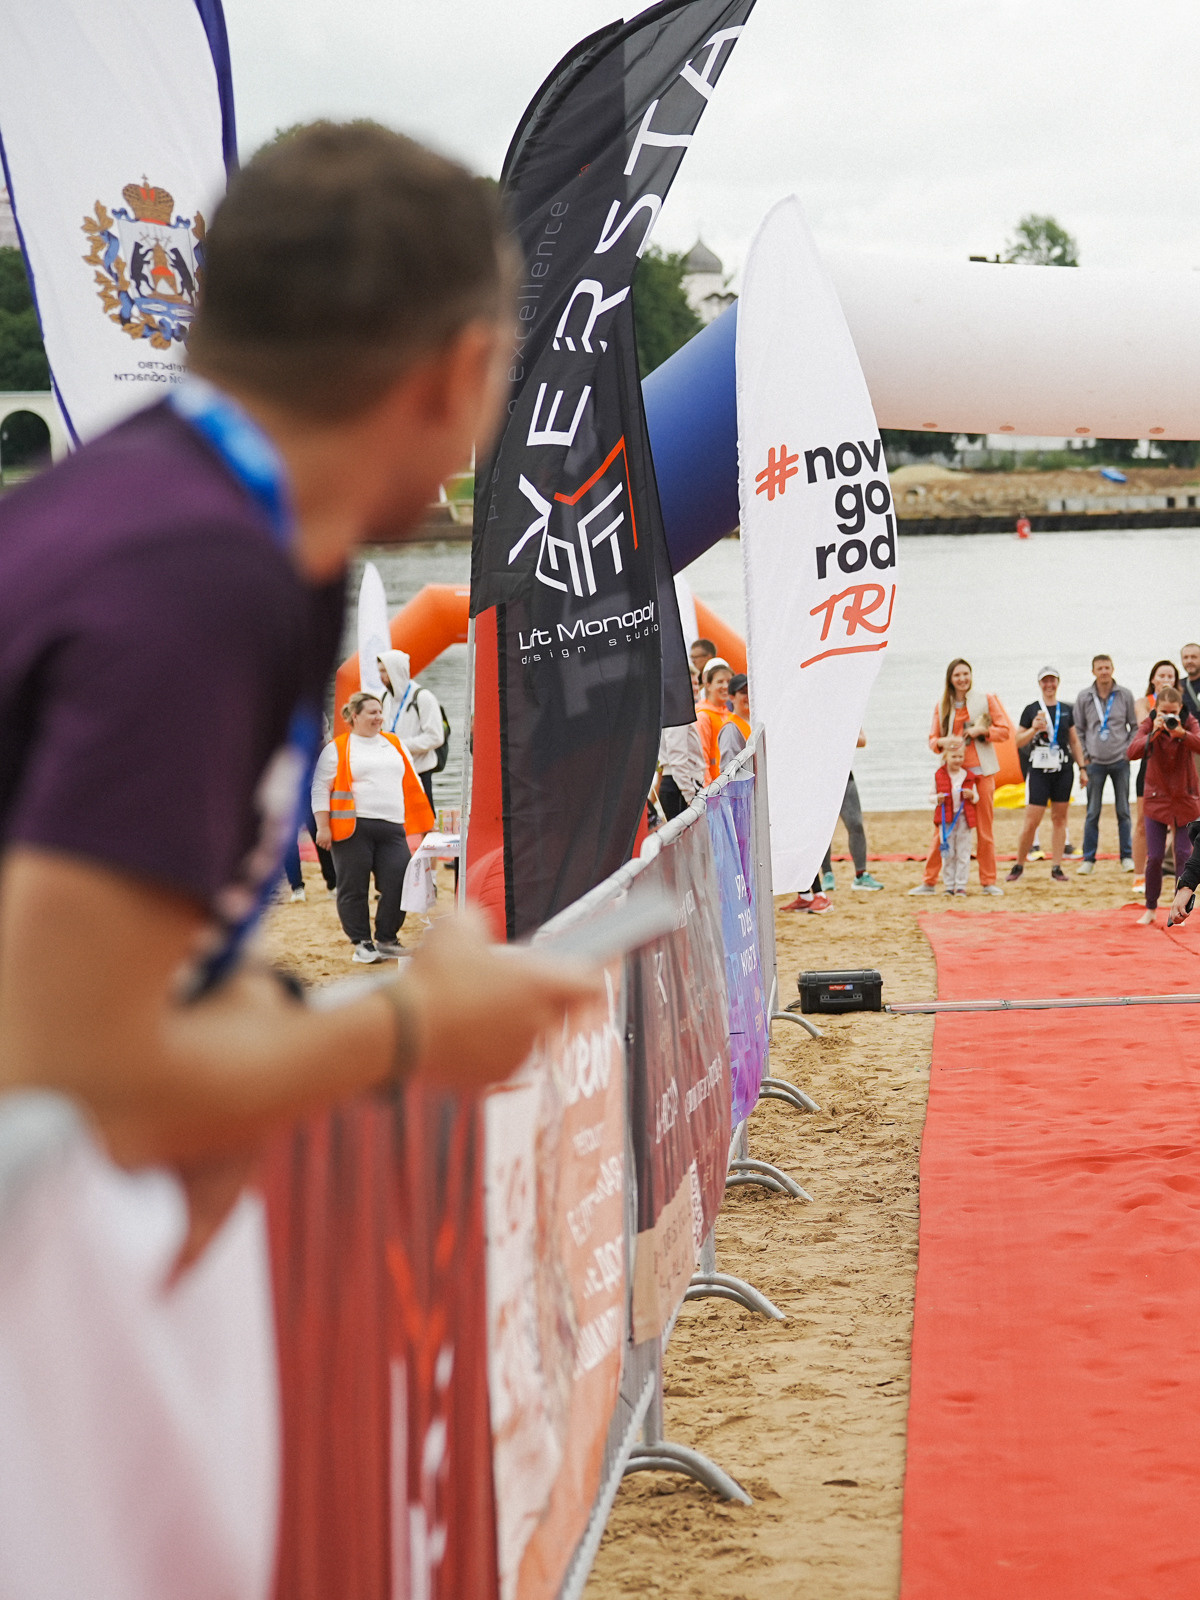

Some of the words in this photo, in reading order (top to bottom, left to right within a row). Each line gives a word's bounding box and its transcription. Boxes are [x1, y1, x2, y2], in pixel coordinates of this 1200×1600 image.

[755, 439, 882, 501] #nov
[835, 480, 891, 535] go
[816, 514, 896, 580] rod
